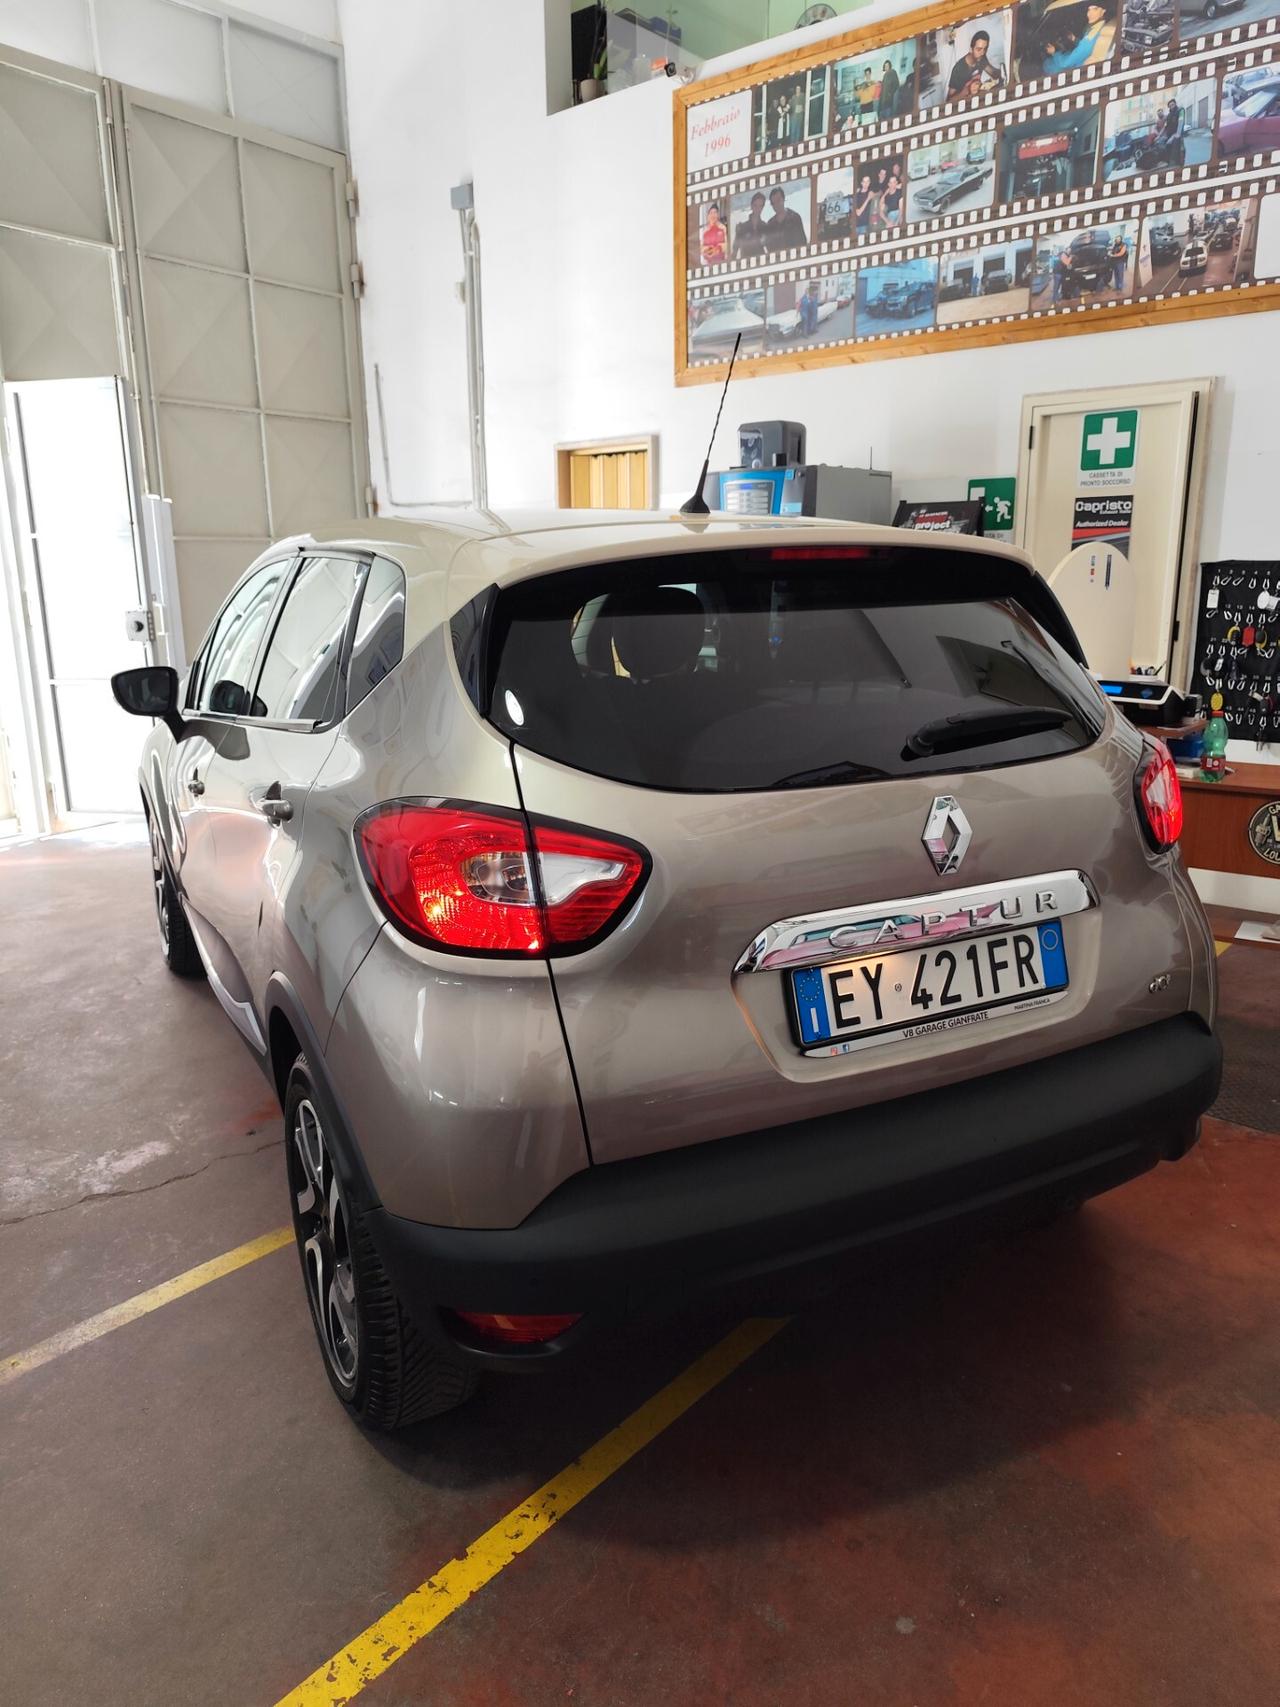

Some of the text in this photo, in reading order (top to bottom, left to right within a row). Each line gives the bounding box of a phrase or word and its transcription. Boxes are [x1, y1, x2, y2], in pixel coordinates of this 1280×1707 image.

[690, 106, 741, 141] Febbraio
[704, 135, 732, 157] 1996
[1089, 471, 1116, 479] CASSETTA
[1102, 478, 1131, 486] SOCCORSO
[1075, 500, 1132, 513] Capristo
[914, 519, 951, 531] project
[1075, 519, 1129, 528] Authorized Dealer
[828, 890, 1058, 949] CAPTUR
[828, 934, 1040, 1029] EY 421FR
[1014, 997, 1051, 1011] MARTINA FRANCA
[902, 1011, 989, 1038] V8 GARAGE GIANFRATE
